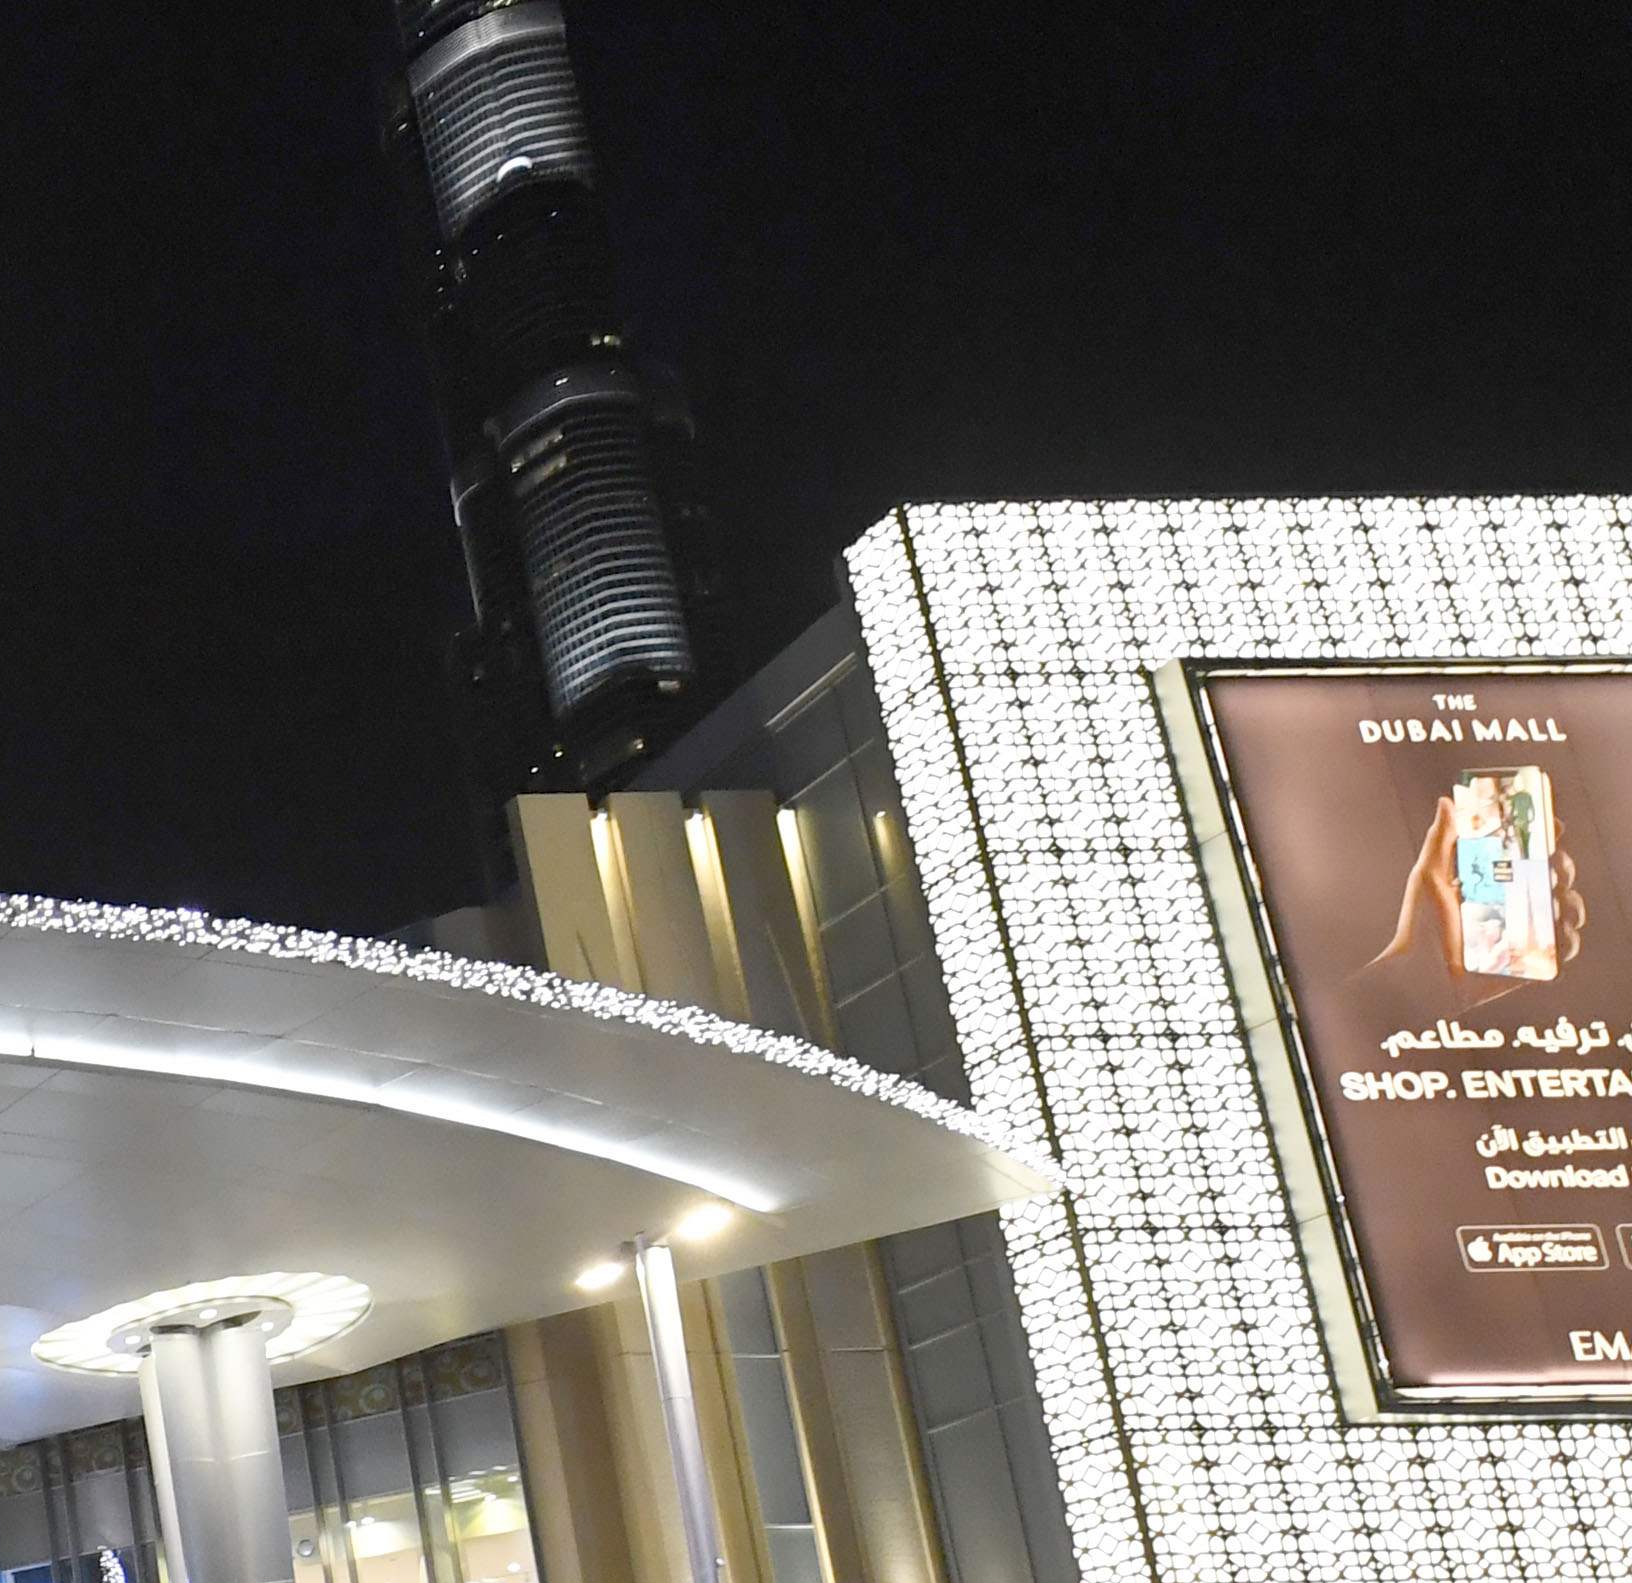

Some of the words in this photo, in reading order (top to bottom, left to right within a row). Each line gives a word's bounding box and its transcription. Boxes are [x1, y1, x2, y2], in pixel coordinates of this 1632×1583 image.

[1432, 694, 1478, 711] THE
[1358, 719, 1464, 744] DUBAI
[1471, 718, 1568, 742] MALL
[1380, 1019, 1505, 1058] مطاعم.
[1339, 1071, 1457, 1101] SHOP.
[1484, 1164, 1630, 1190] Download
[1498, 1242, 1542, 1267] App
[1541, 1241, 1598, 1263] Store
[1569, 1330, 1632, 1361] EM
